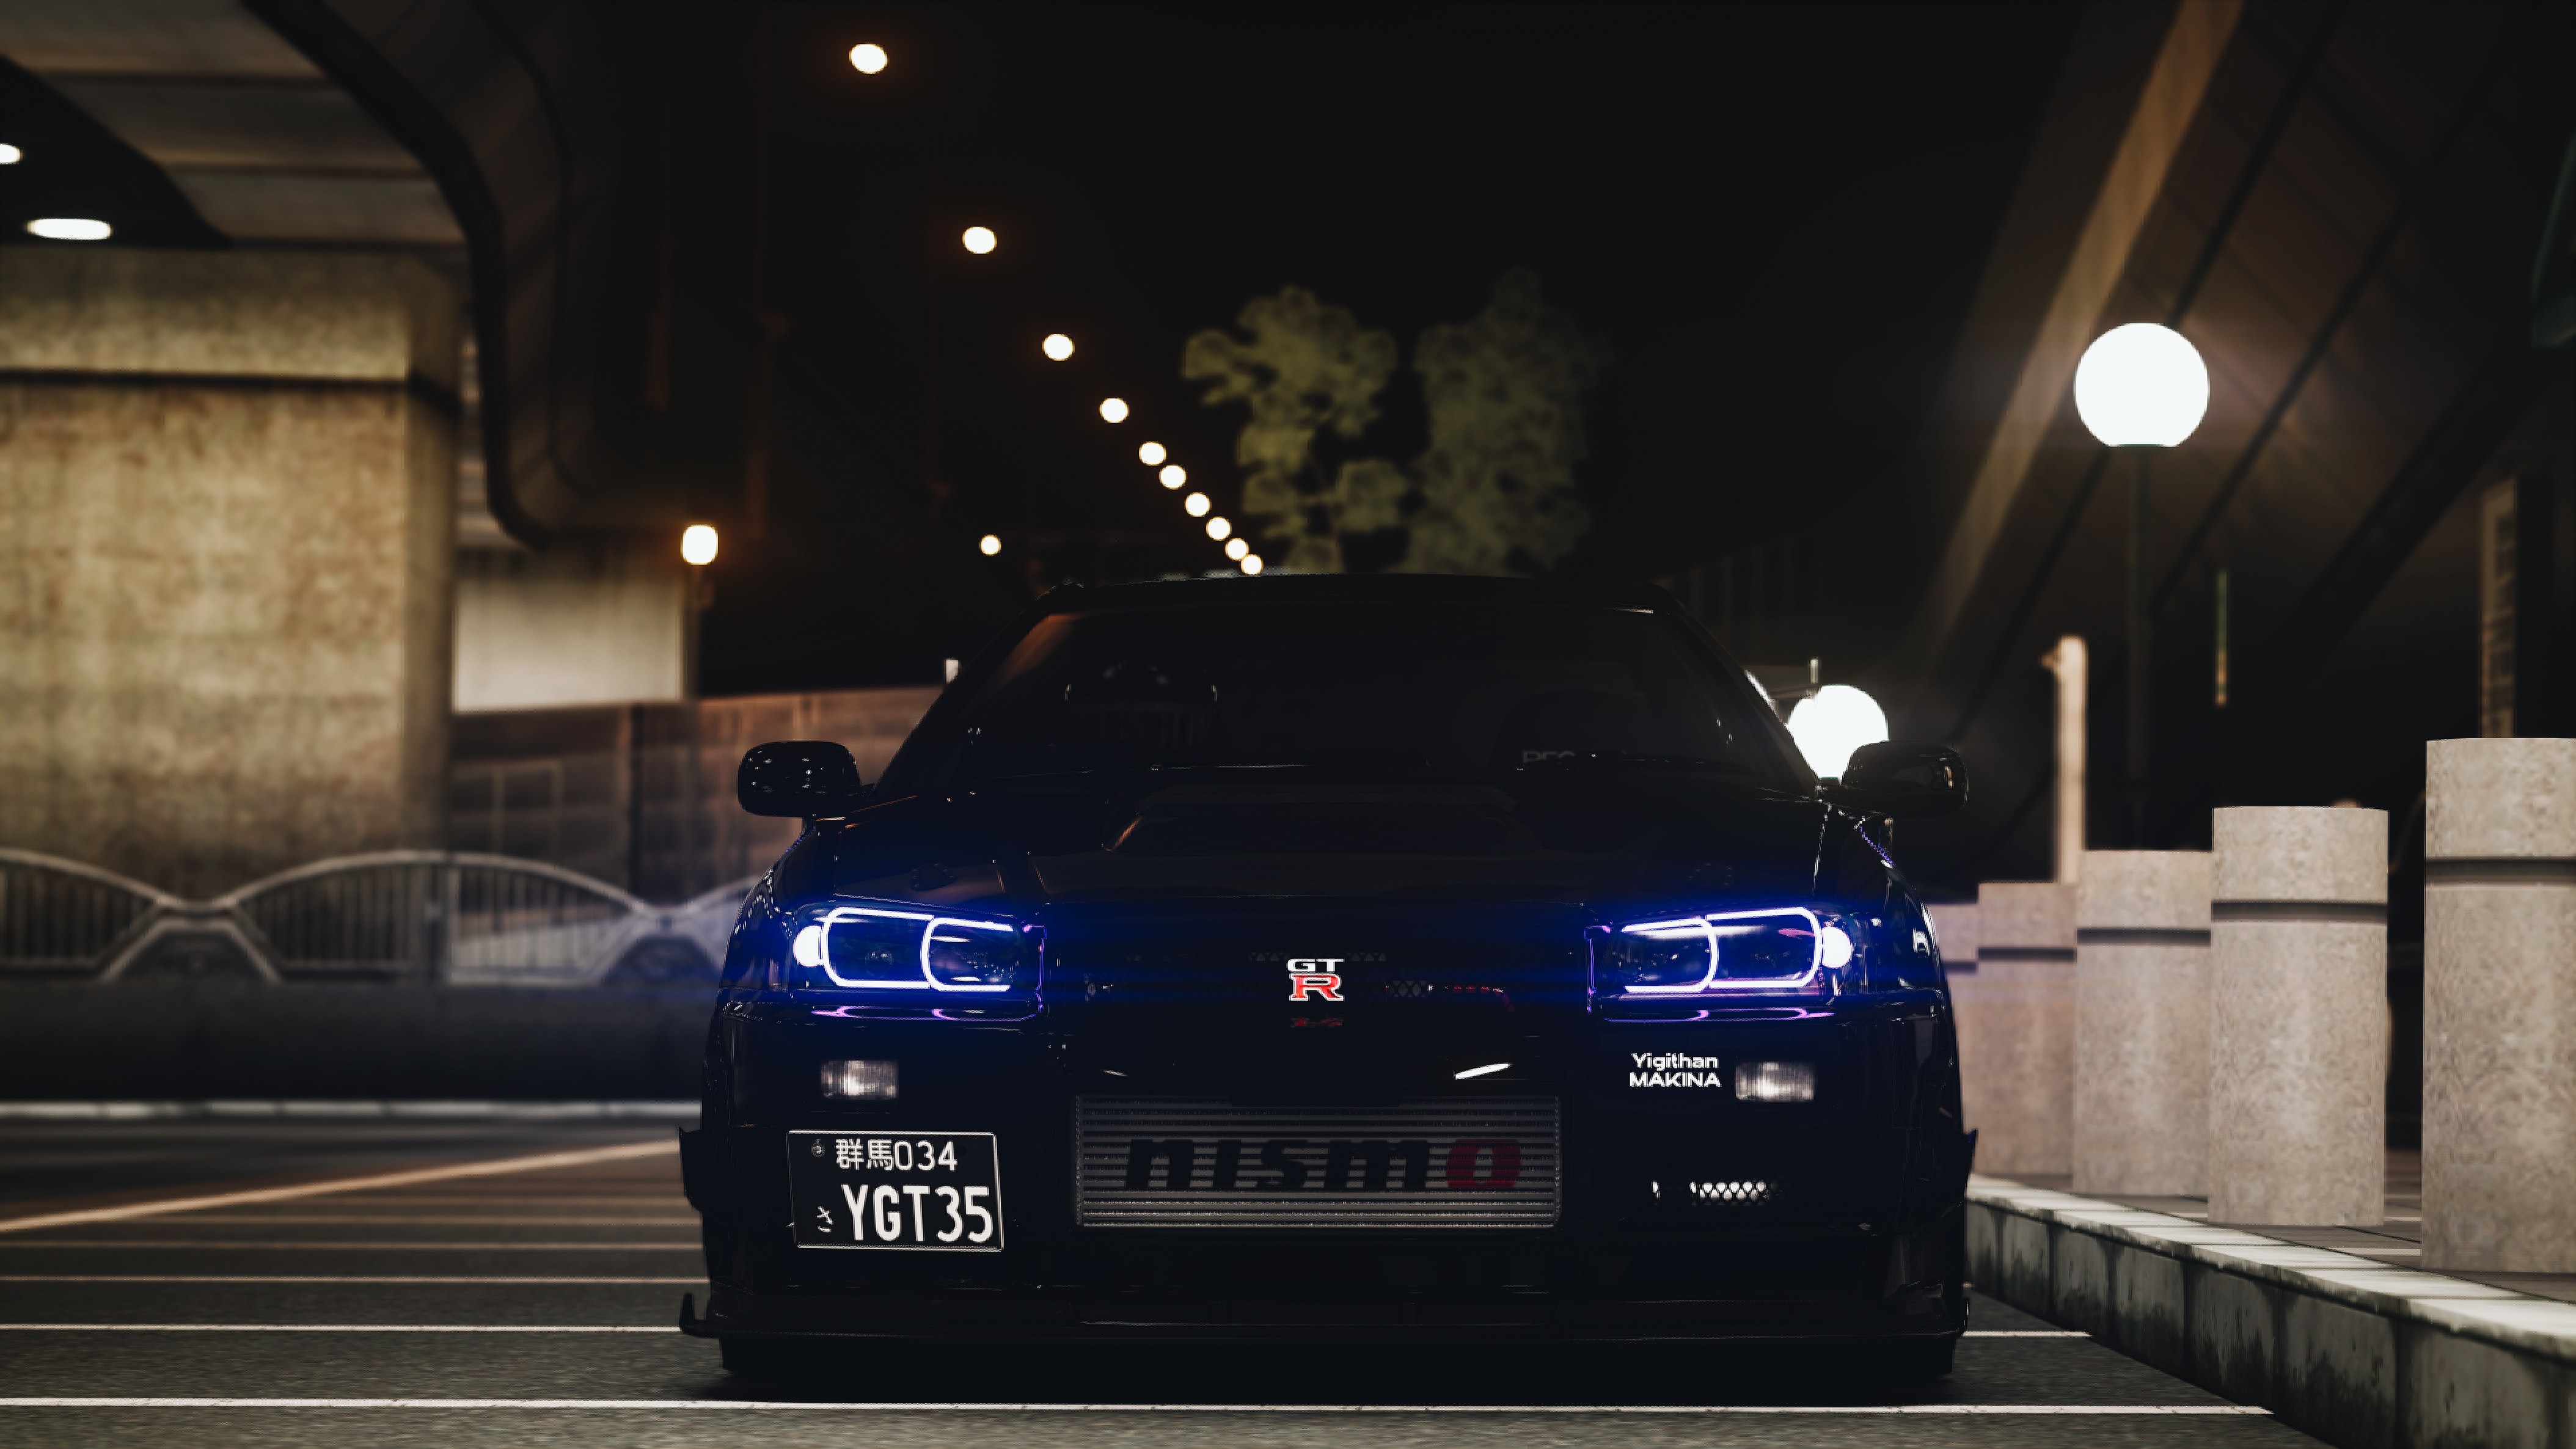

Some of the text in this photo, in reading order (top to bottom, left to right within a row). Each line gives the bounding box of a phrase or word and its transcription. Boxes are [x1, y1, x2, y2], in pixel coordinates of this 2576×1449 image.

[1287, 958, 1345, 972] GT
[1289, 973, 1345, 1001] R
[1631, 1053, 1718, 1071] Yigithan
[1630, 1072, 1722, 1087] MAKINA
[1125, 1139, 1522, 1188] nismo
[841, 1184, 993, 1243] YGT35
